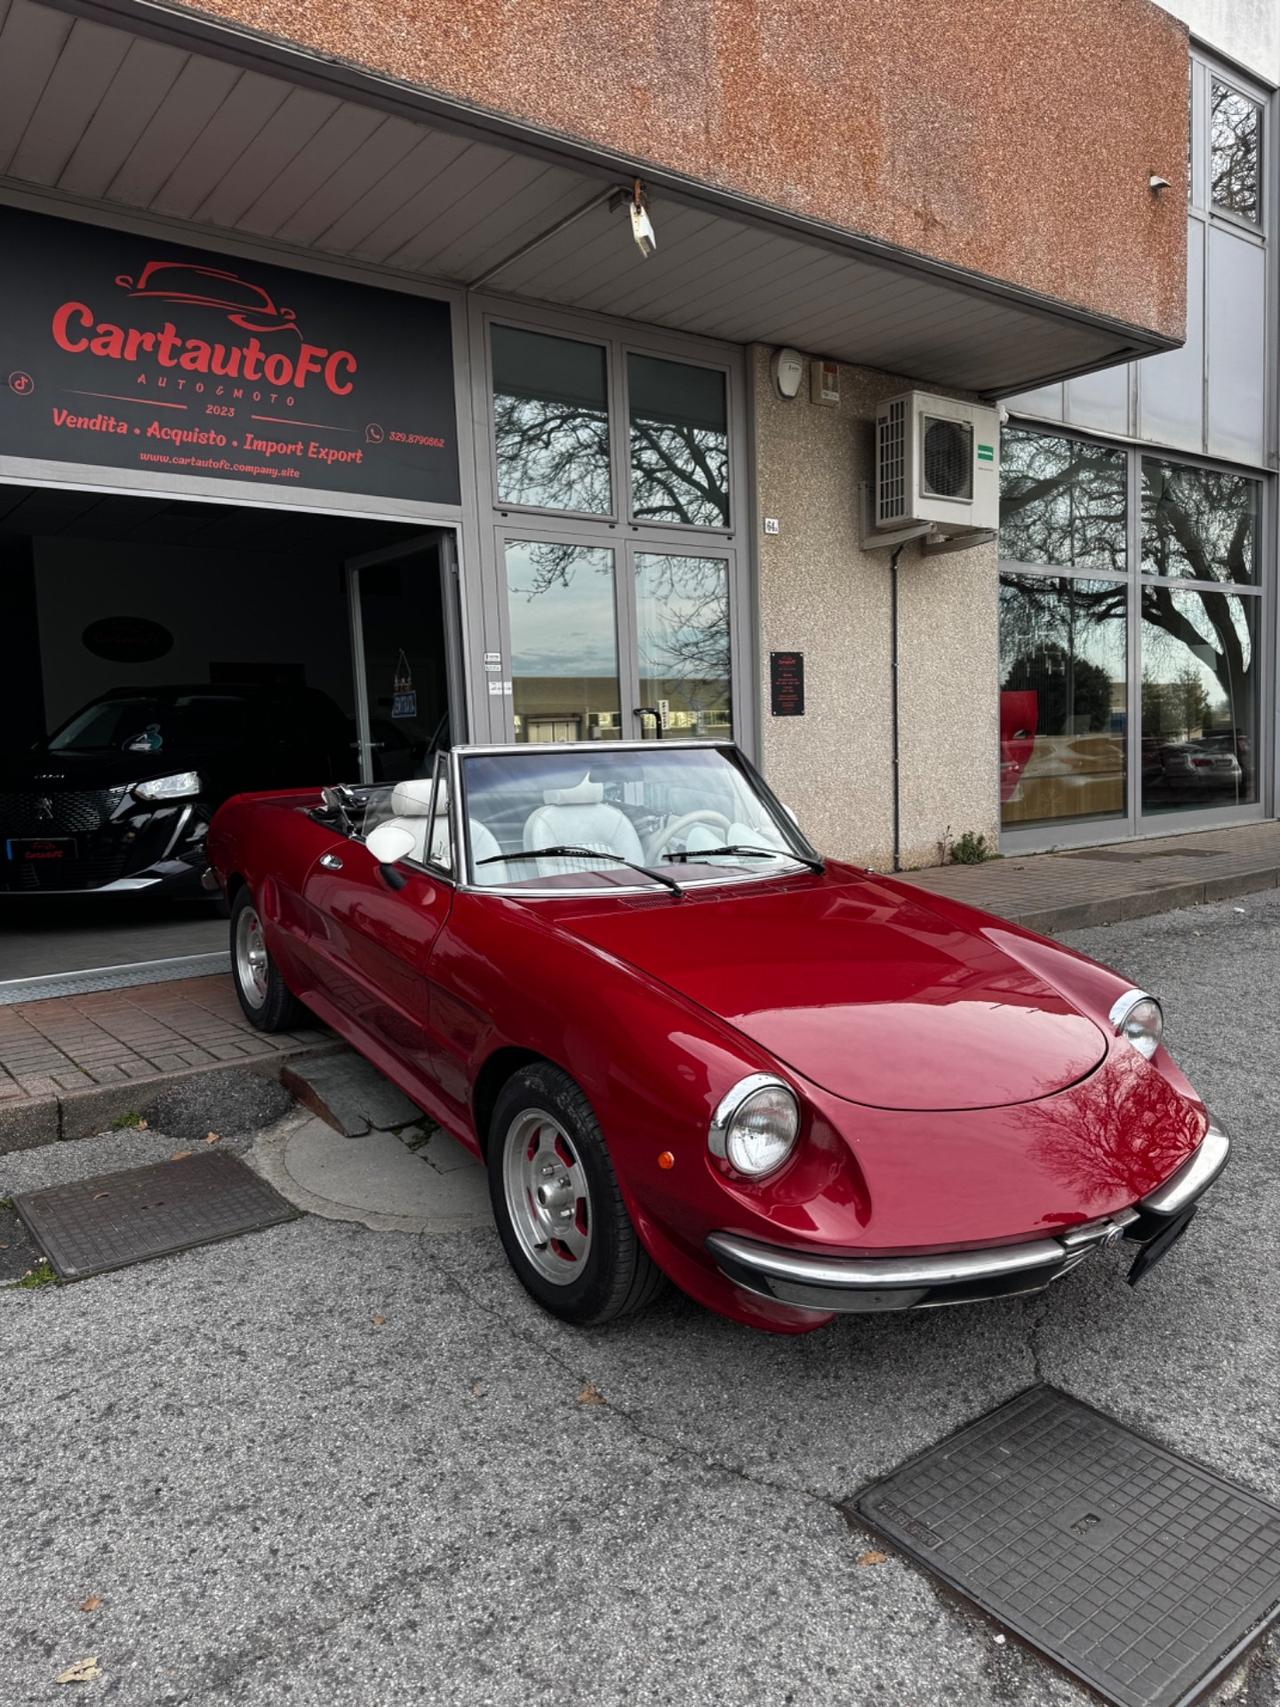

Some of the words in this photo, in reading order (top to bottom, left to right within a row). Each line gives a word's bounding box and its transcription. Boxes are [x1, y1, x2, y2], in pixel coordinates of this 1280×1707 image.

[51, 301, 357, 396] CartautoFC
[206, 404, 236, 417] 2023
[51, 407, 129, 434] Vendita
[145, 420, 227, 447] Acquisto
[243, 432, 304, 457] Import
[307, 441, 363, 465] Export
[139, 451, 300, 478] www.cartautofc.company.site
